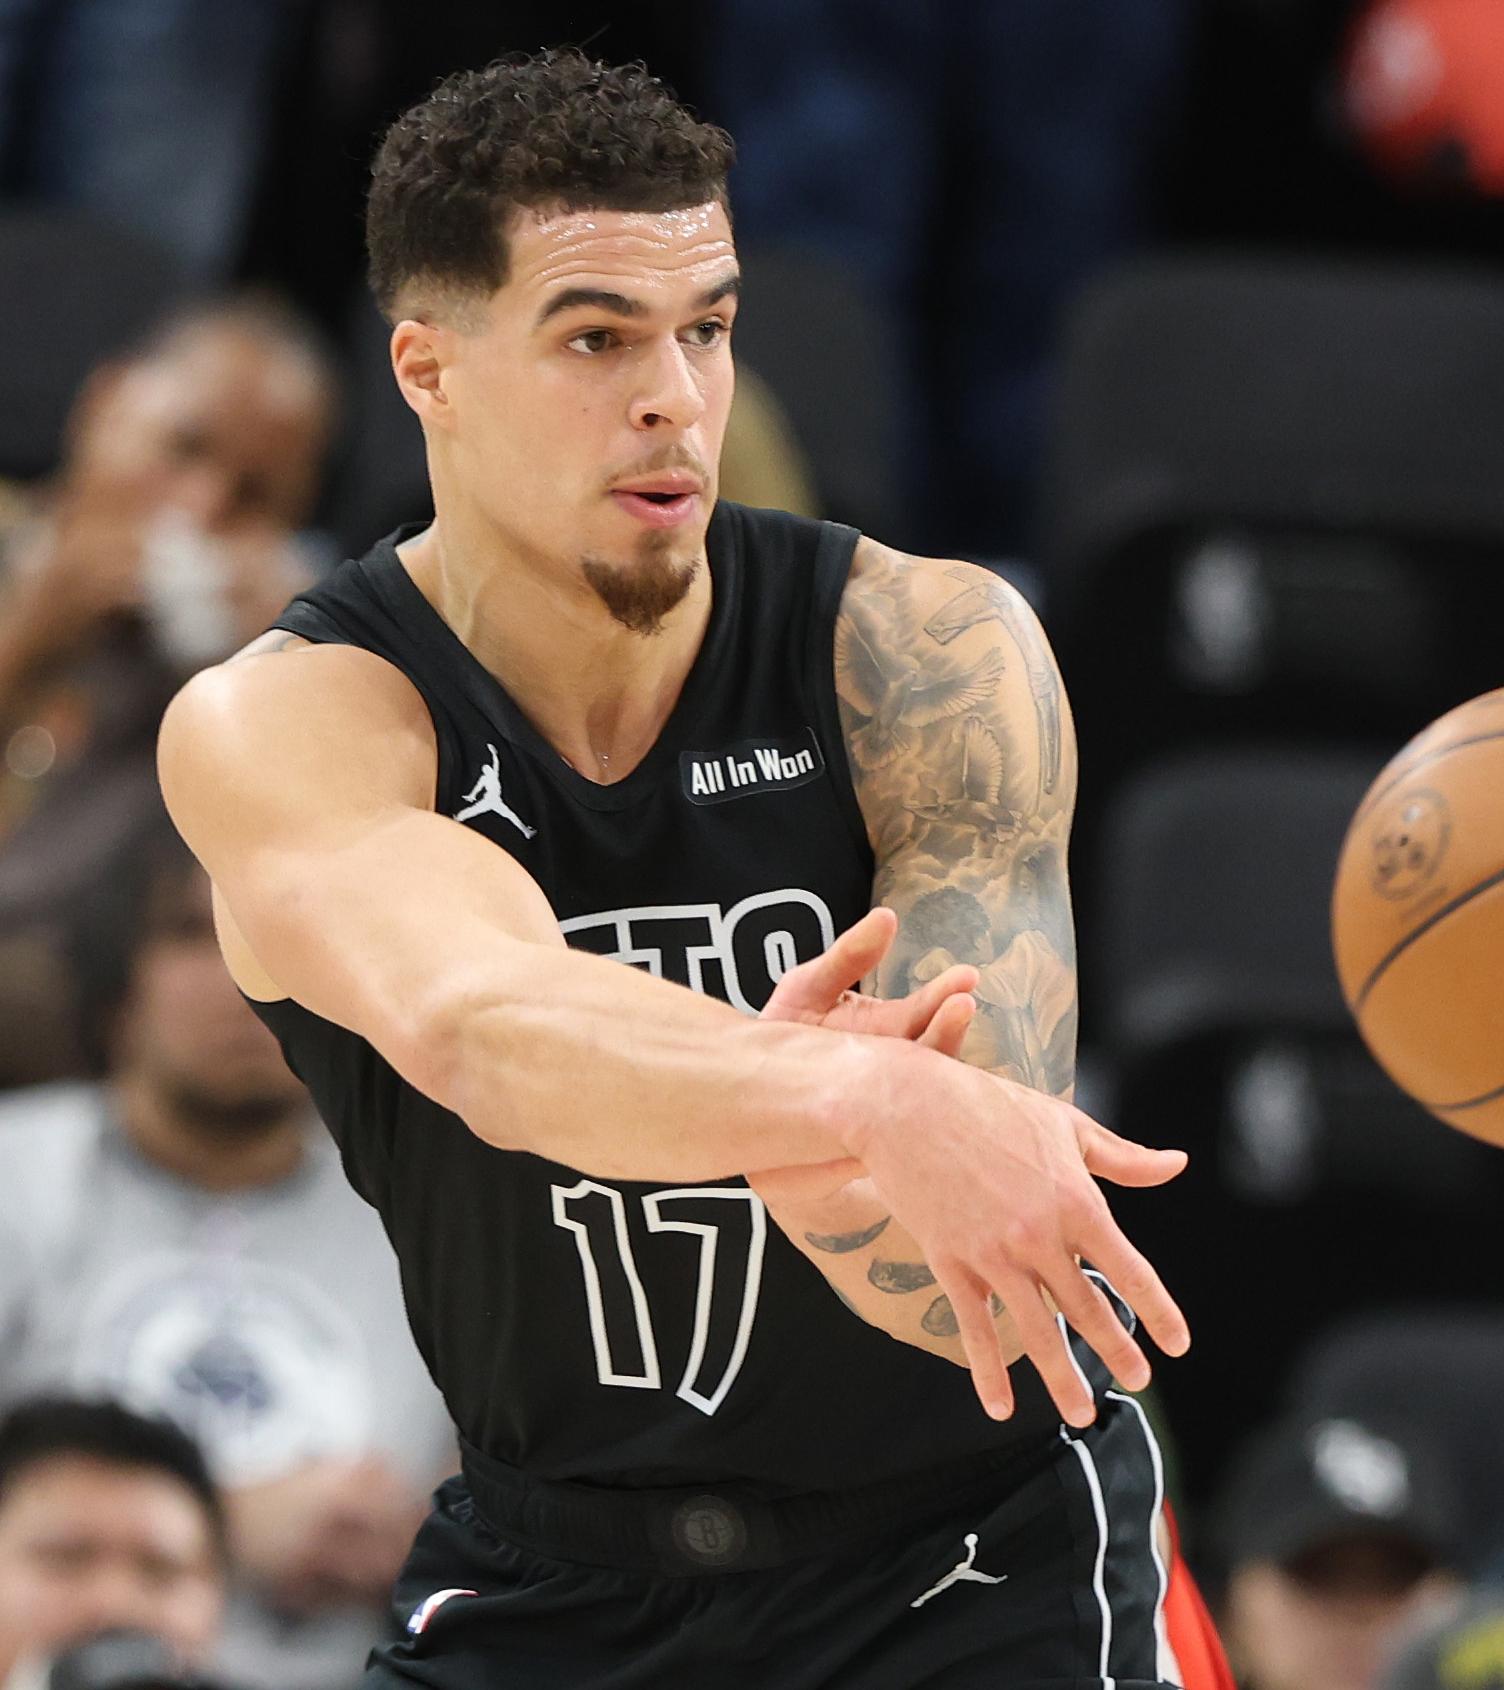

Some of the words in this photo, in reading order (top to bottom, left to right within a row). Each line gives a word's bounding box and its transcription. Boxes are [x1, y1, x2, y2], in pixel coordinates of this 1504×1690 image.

[692, 761, 726, 795] All
[726, 756, 758, 787] In
[754, 748, 815, 781] Won
[550, 1179, 767, 1417] 17
